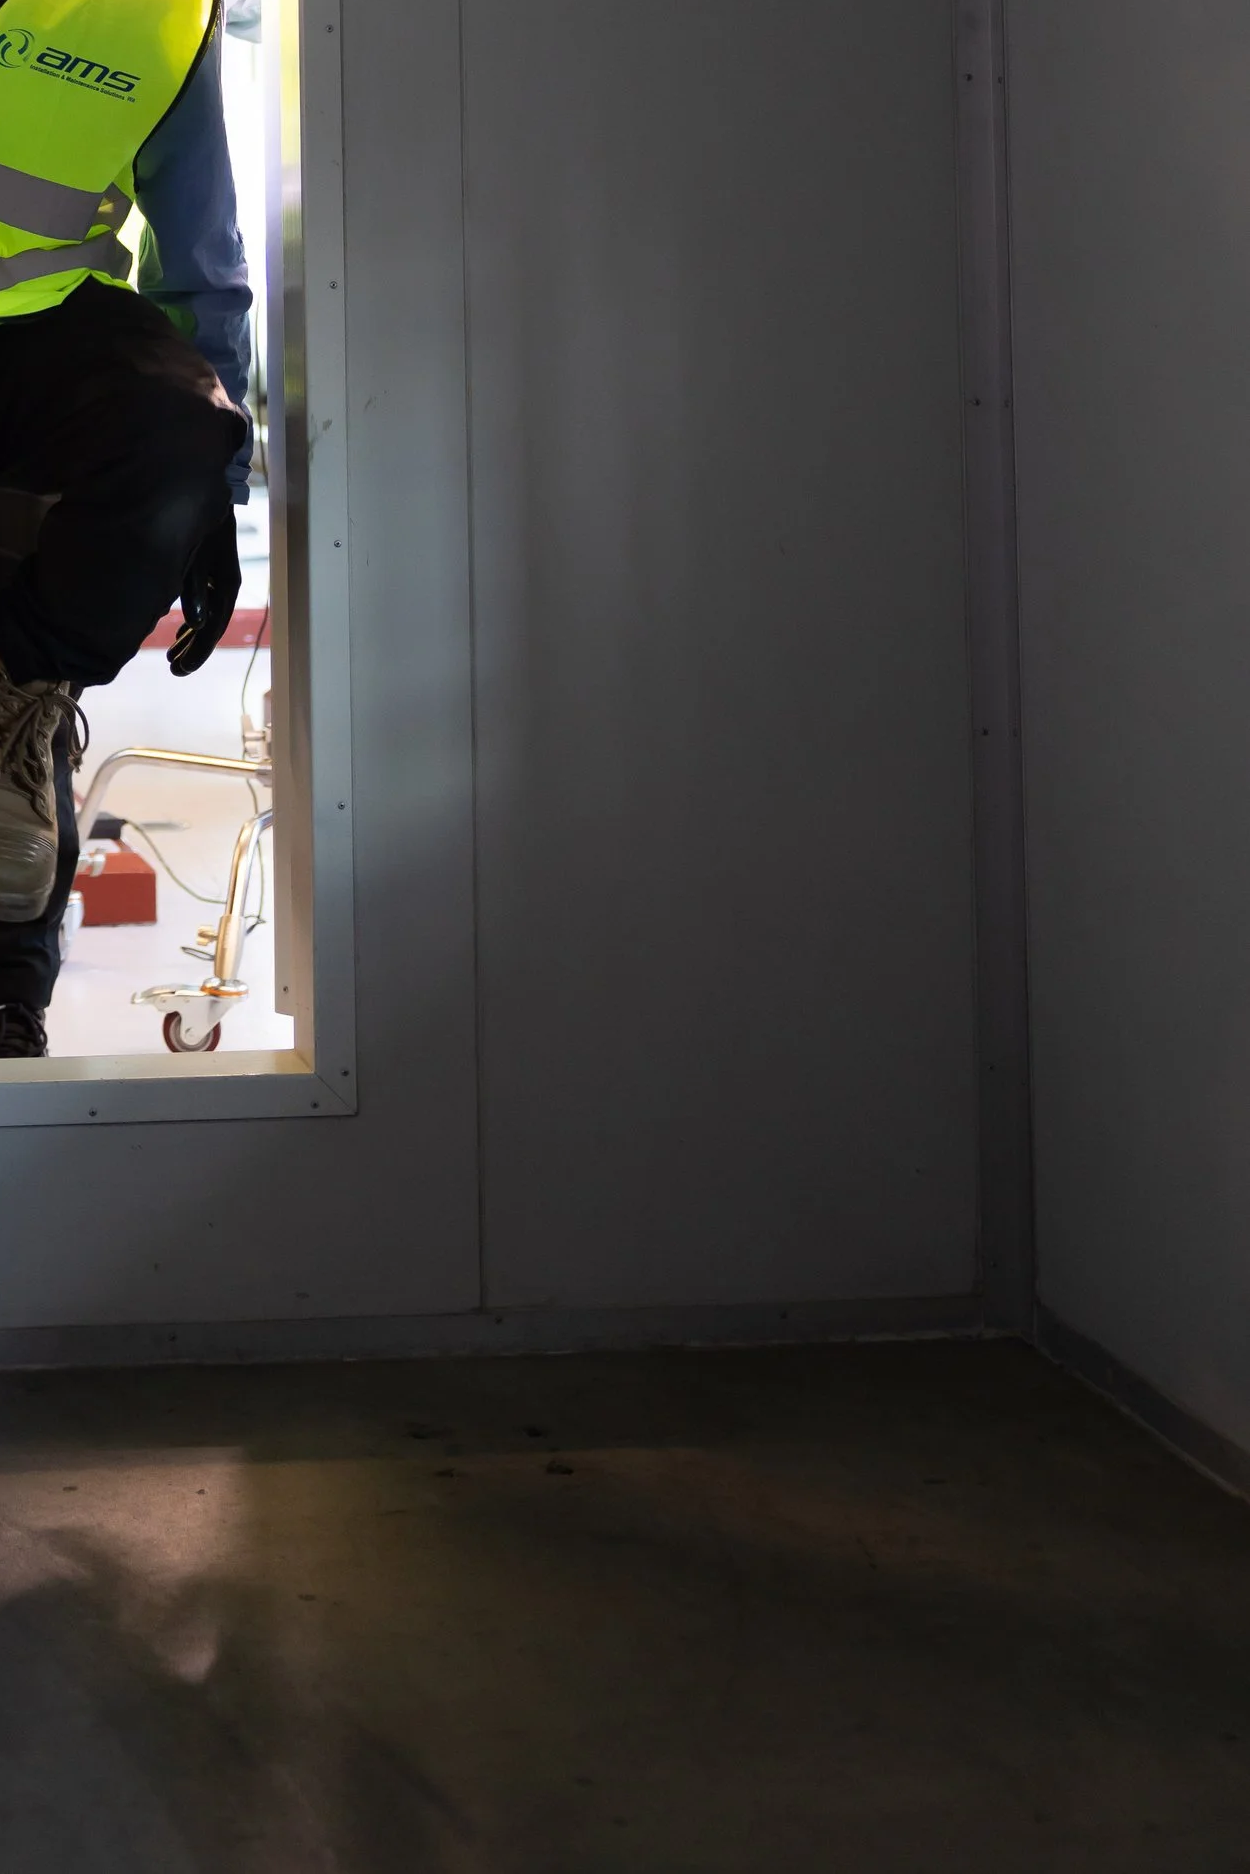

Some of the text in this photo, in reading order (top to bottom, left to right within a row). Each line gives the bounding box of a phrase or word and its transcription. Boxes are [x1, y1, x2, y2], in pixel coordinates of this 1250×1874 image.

[30, 64, 61, 79] Installation
[66, 76, 100, 92] Maintenance
[99, 87, 125, 101] Solutions
[36, 46, 142, 93] ams
